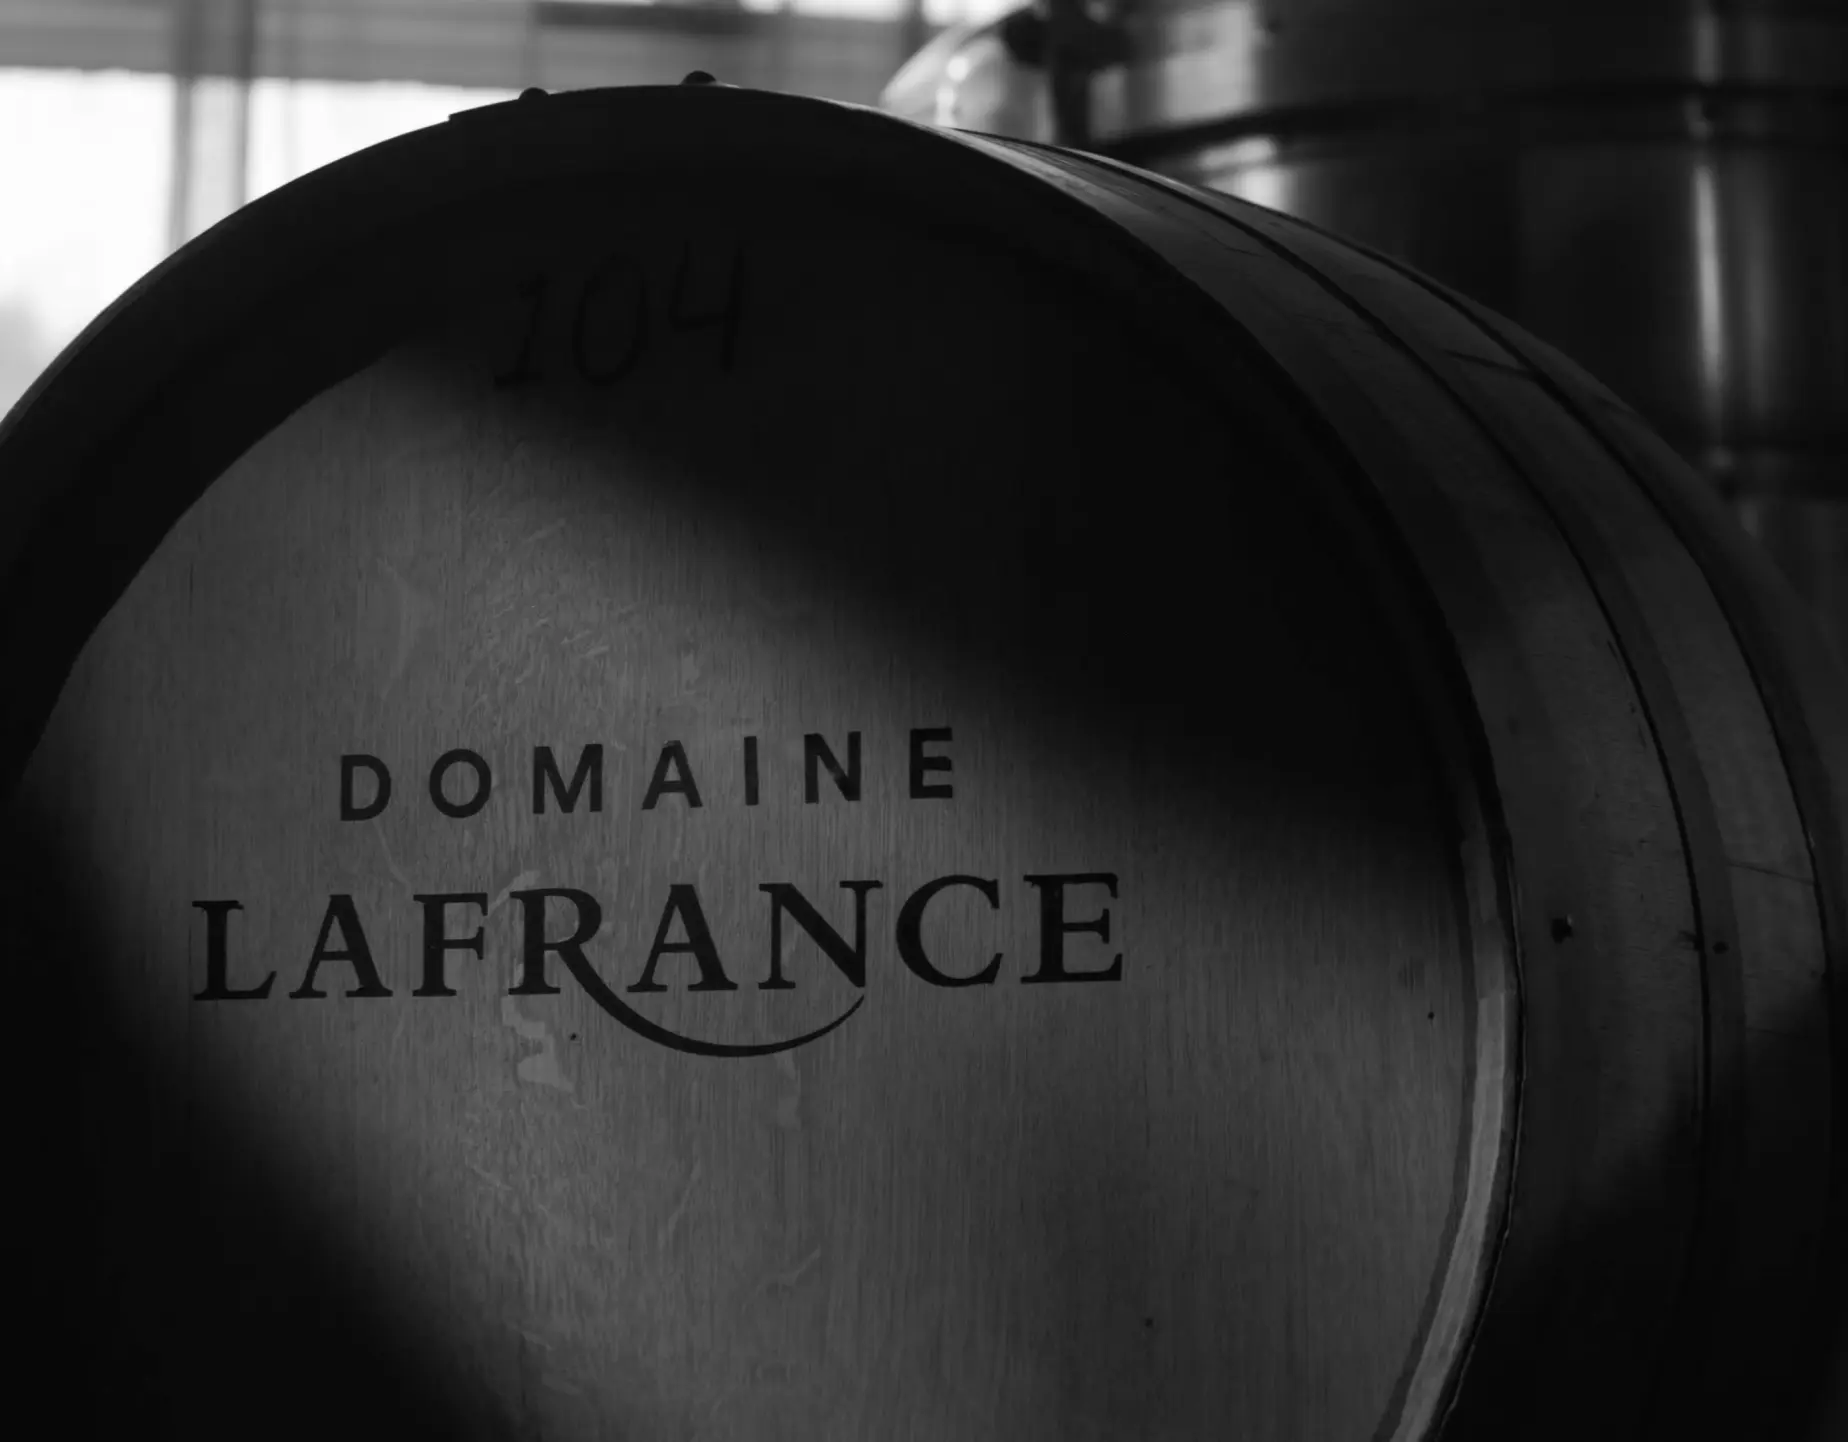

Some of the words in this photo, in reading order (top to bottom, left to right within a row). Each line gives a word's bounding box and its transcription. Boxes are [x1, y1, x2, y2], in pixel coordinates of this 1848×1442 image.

[494, 238, 746, 390] 104
[339, 727, 954, 823] DOMAINE
[192, 872, 1124, 1058] LAFRANCE
